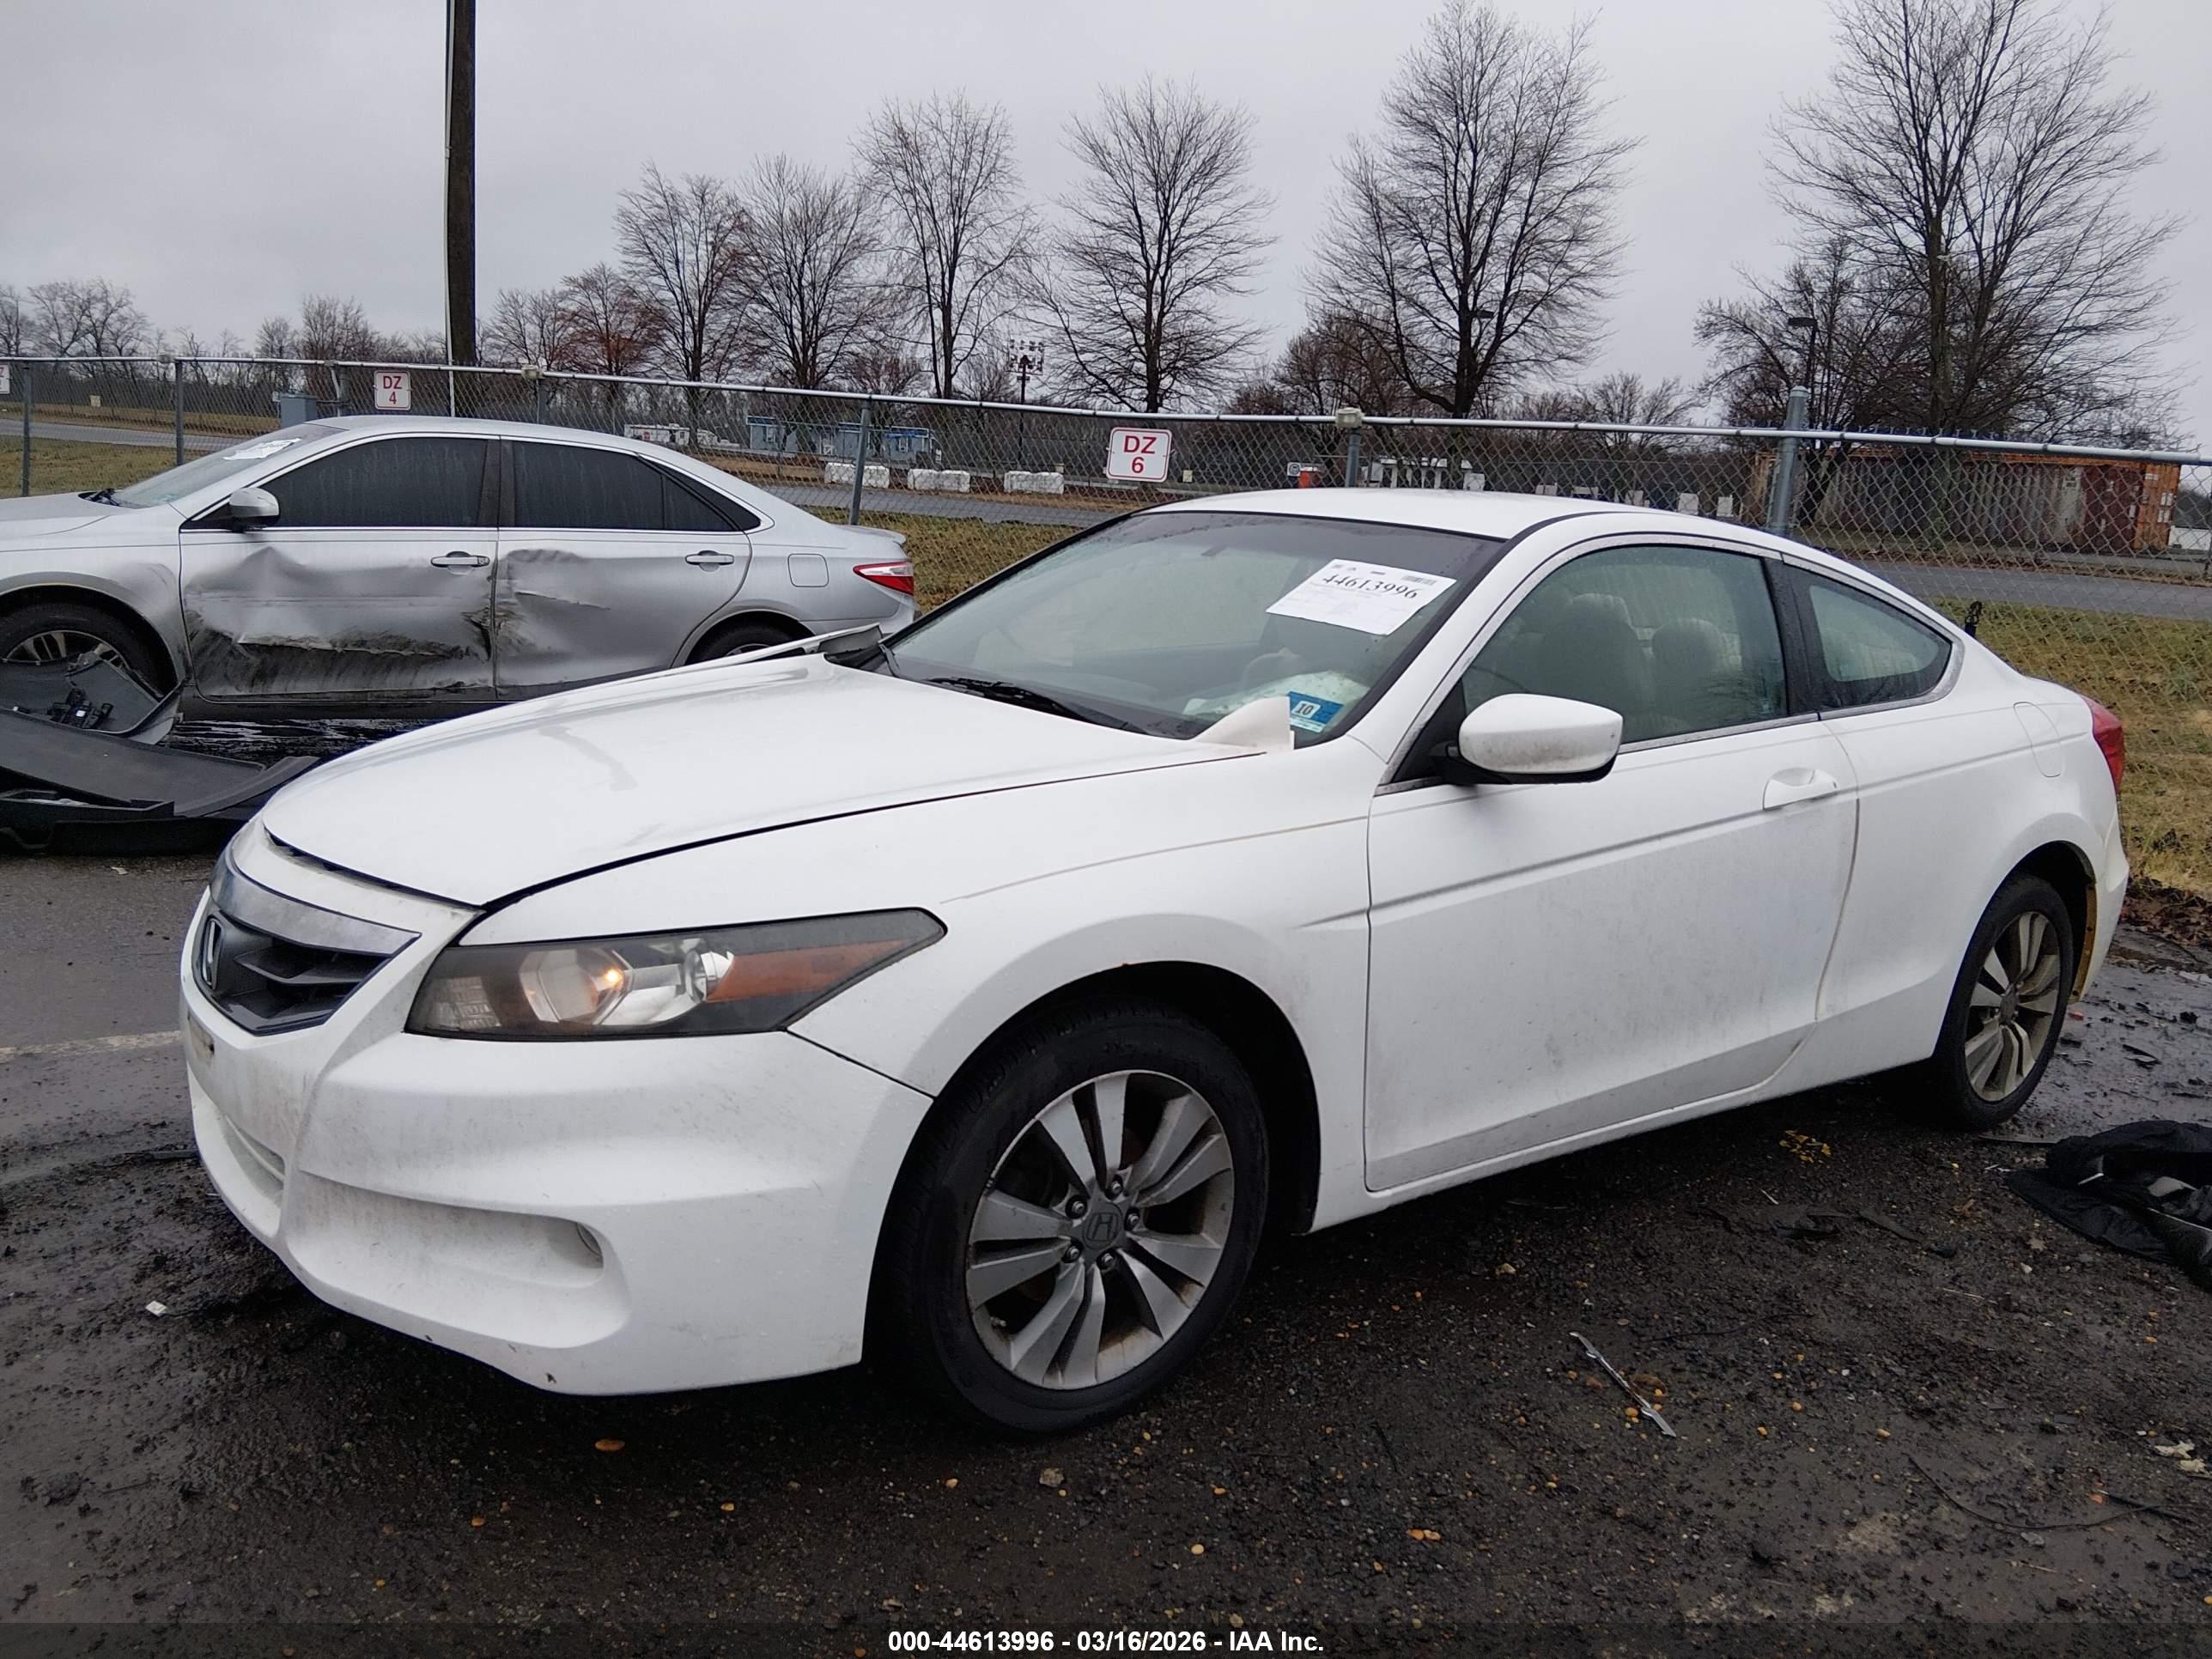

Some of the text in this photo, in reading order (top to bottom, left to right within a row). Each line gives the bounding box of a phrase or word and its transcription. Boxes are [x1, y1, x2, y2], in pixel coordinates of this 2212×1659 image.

[383, 376, 402, 389] DZ
[389, 392, 397, 404] 4
[1123, 435, 1157, 454] DZ
[1132, 457, 1144, 473] 6
[1323, 574, 1418, 599] 44613996
[1295, 703, 1314, 715] 10
